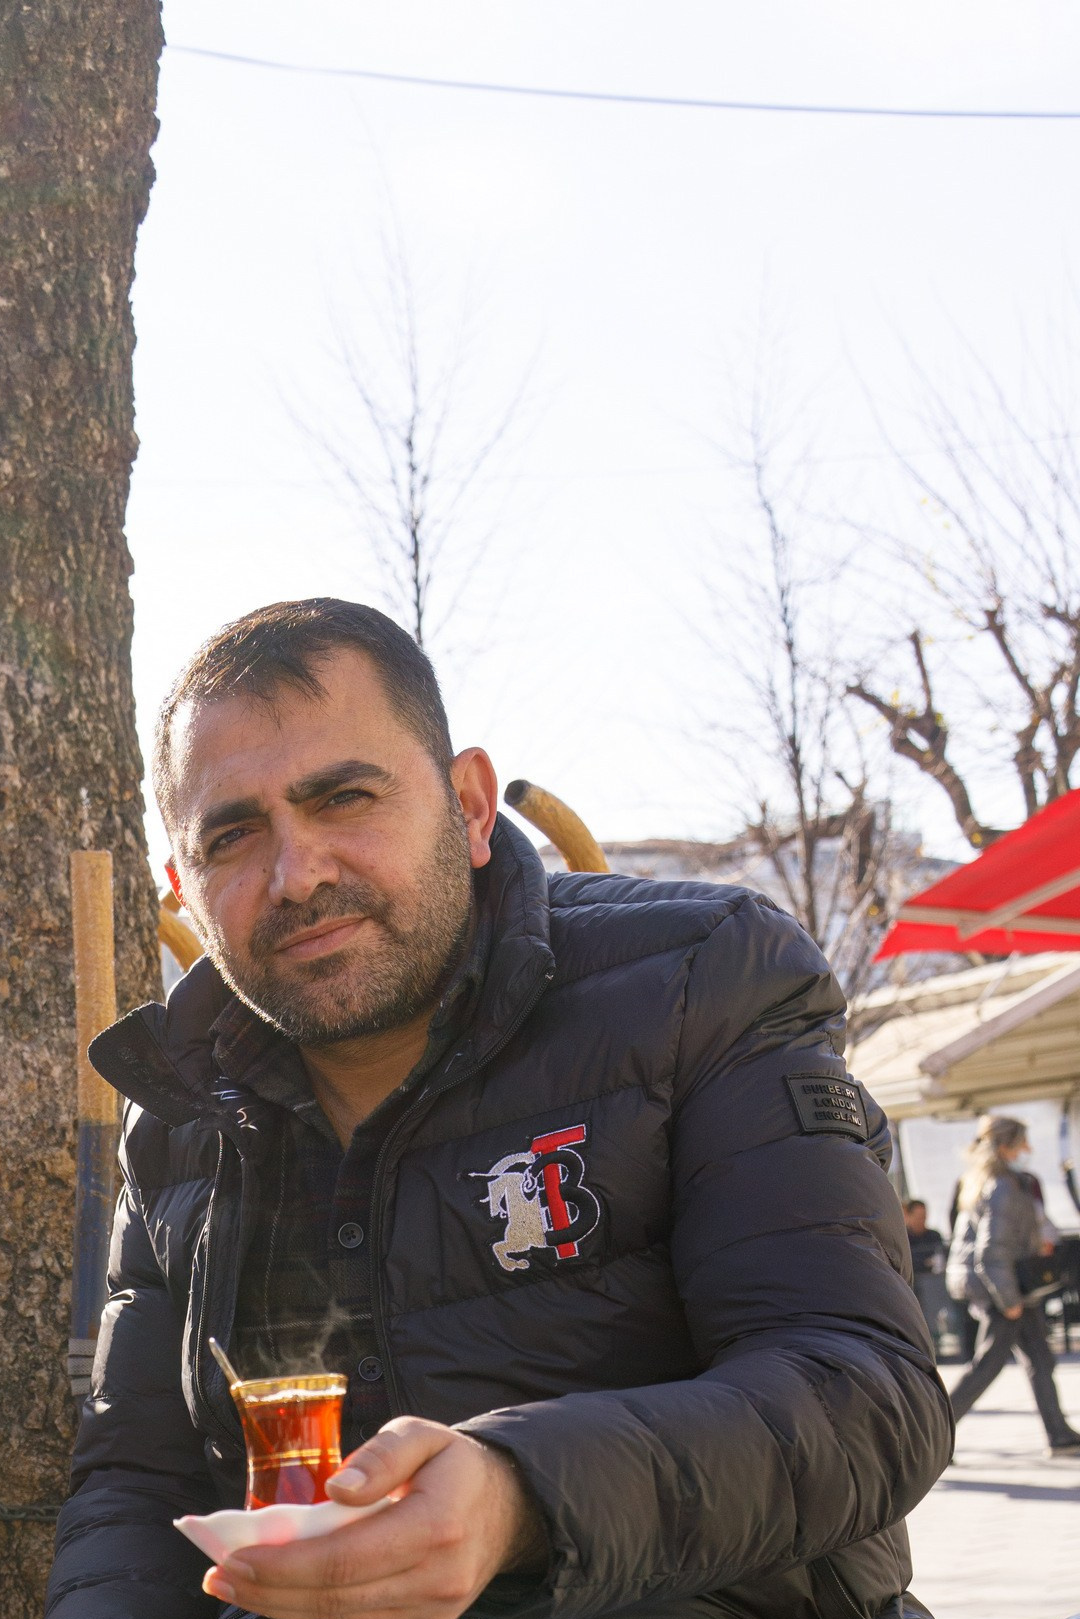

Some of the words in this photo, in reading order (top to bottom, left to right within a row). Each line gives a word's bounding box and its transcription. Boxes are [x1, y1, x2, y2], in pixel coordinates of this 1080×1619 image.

[802, 1084, 856, 1099] BURBERRY
[813, 1098, 857, 1113] LONDON
[815, 1111, 862, 1126] ENGLAND
